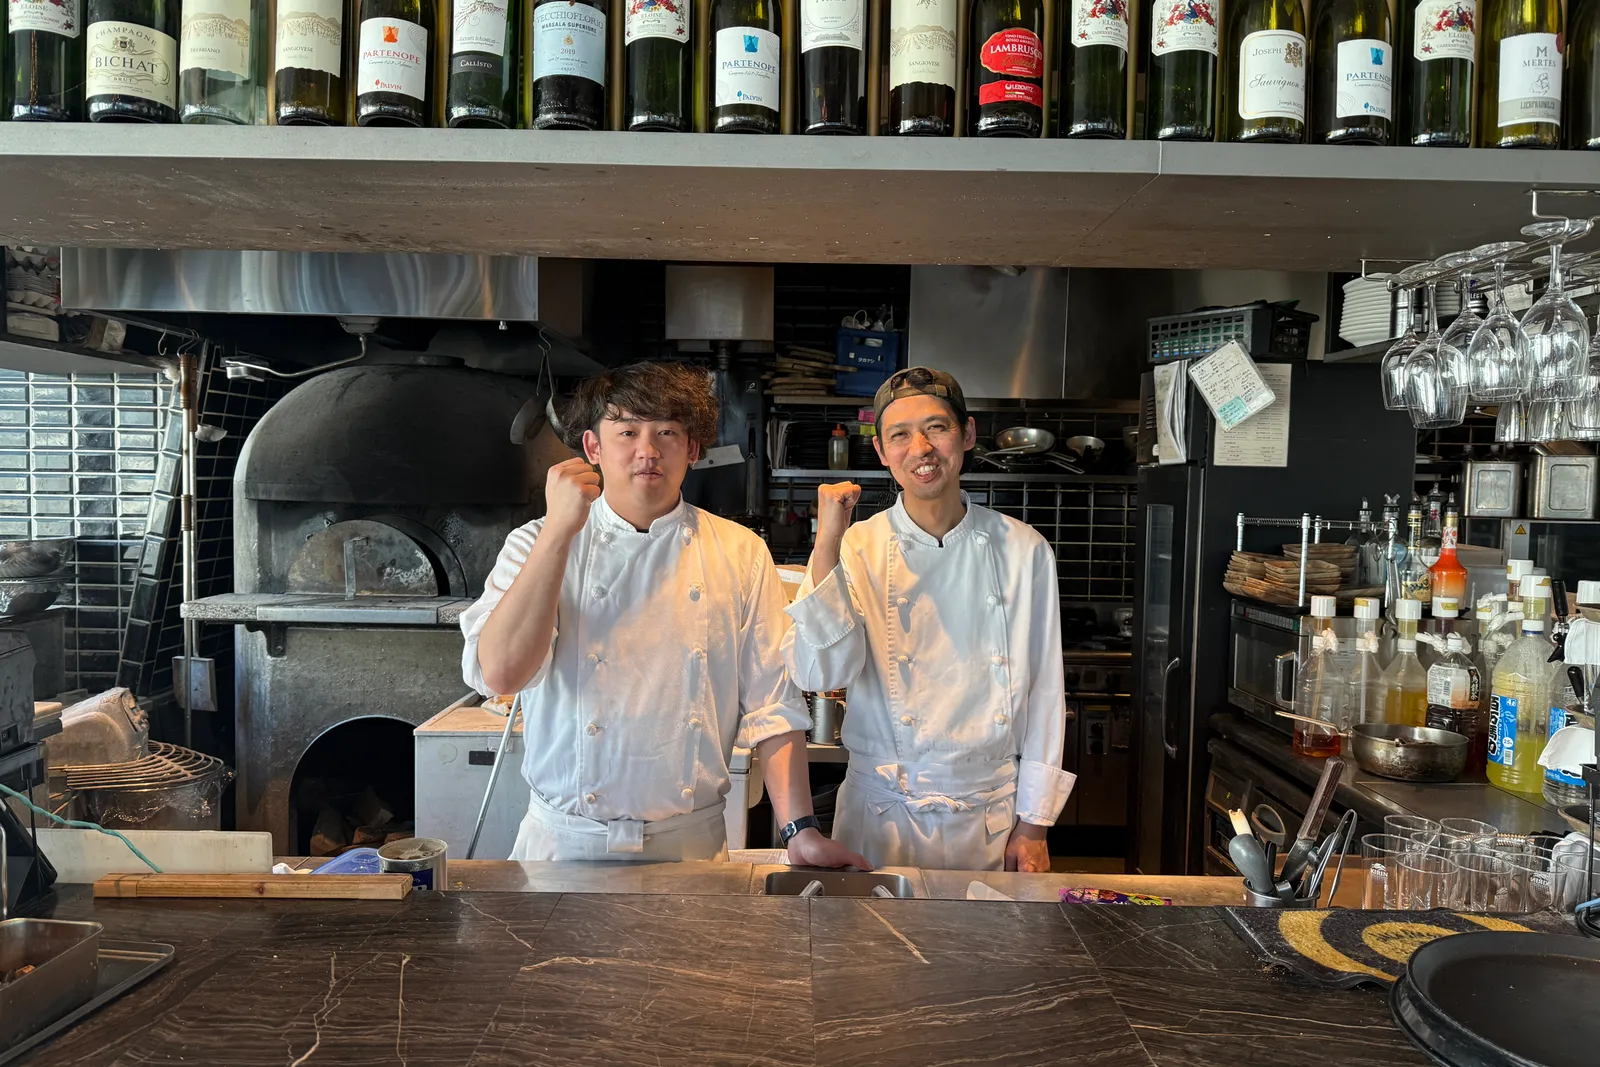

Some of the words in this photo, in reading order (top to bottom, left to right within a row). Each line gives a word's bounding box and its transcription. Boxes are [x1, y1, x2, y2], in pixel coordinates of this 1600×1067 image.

[96, 27, 157, 47] CHAMPAGNE
[363, 49, 421, 65] PARTENOPE
[990, 43, 1043, 60] LAMBRUSCO
[1252, 47, 1282, 57] JOSEPH
[95, 56, 158, 74] BICHAT
[722, 59, 776, 75] PARTENOPE
[1522, 59, 1557, 68] MERTES
[1249, 73, 1300, 91] Sauvignon
[1370, 867, 1389, 878] KIRIN
